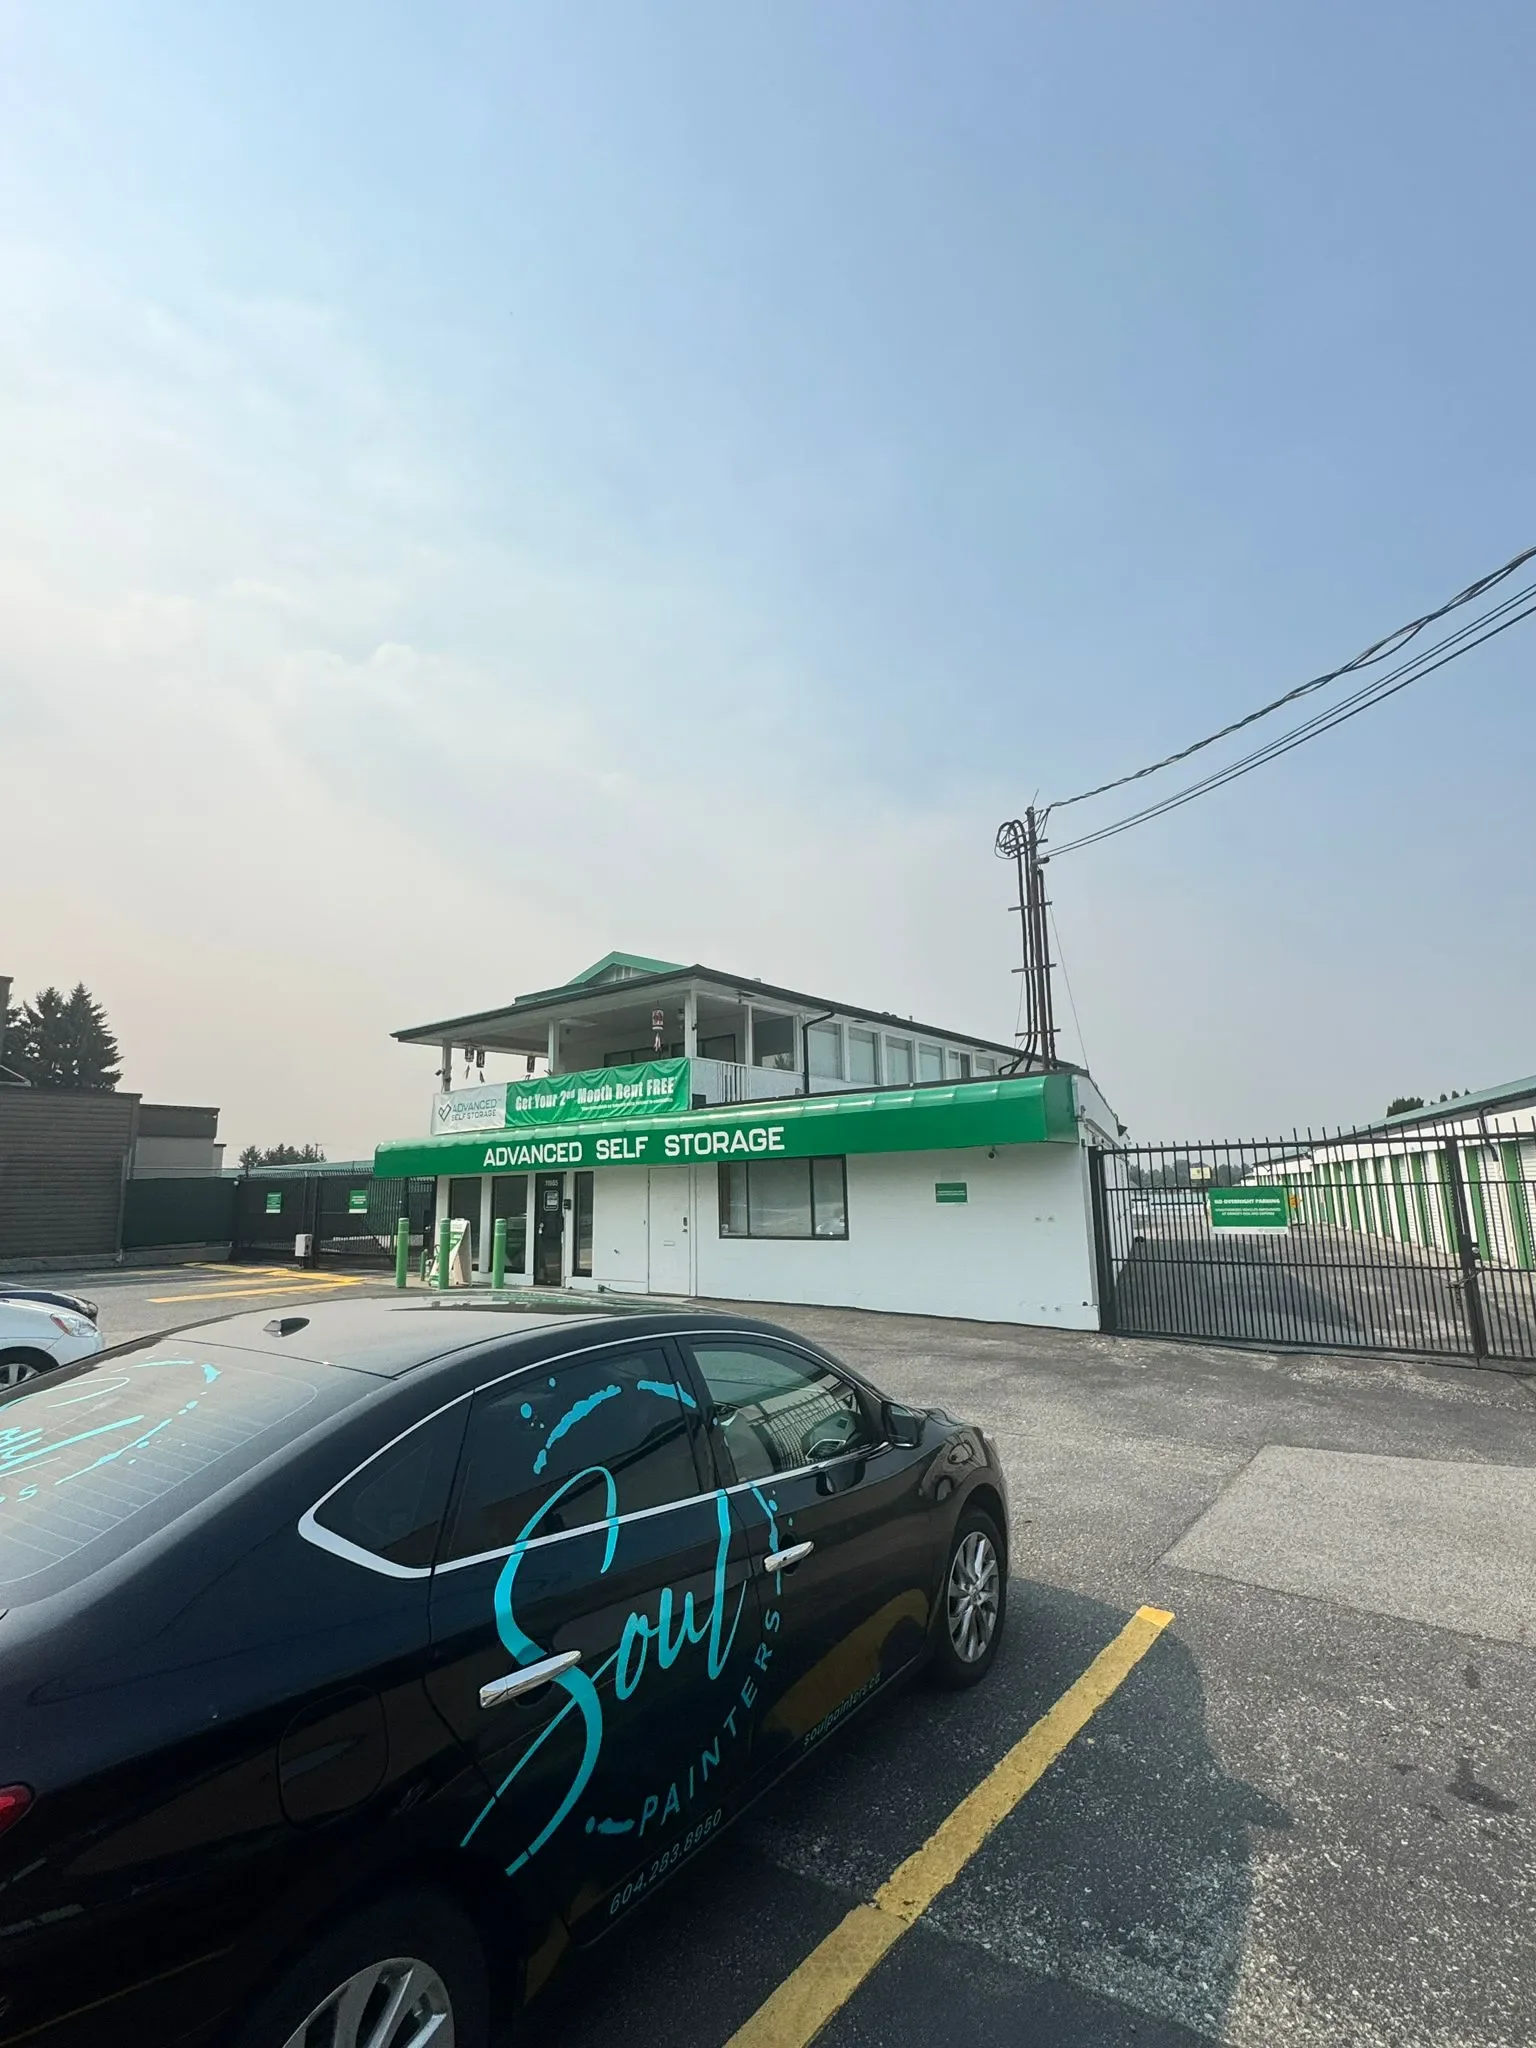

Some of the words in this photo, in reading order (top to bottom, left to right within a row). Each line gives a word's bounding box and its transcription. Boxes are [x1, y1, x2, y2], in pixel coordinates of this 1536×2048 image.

[452, 1098, 498, 1113] ADVANCED
[466, 1109, 497, 1120] STORAGE
[515, 1096, 532, 1111] Get
[534, 1093, 558, 1109] Your
[560, 1089, 576, 1106] 2nd
[577, 1084, 613, 1104] Month
[615, 1082, 643, 1100] Rent
[483, 1141, 583, 1167] ADVANCED
[596, 1136, 649, 1160] SELF
[664, 1127, 785, 1157] STORAGE
[460, 1466, 747, 1876] Soul
[638, 1608, 781, 1837] PAINTERS
[609, 1808, 722, 1915] 604.283.8950
